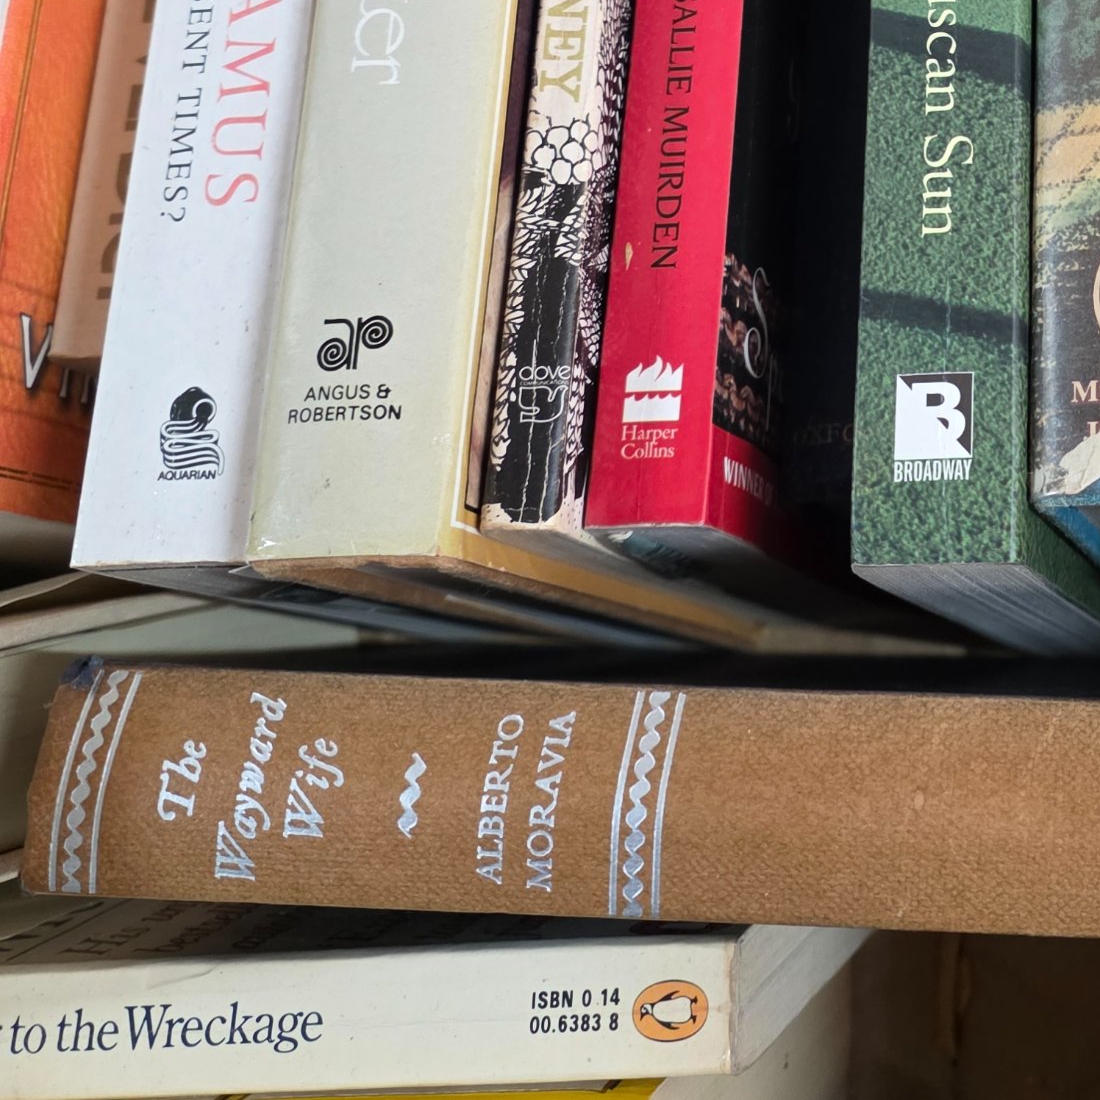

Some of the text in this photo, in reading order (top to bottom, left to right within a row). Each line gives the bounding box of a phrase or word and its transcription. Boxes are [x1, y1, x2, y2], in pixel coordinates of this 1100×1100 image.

[160, 86, 203, 223] TIMES?
[650, 106, 689, 270] MUIRDEN
[921, 132, 976, 238] Sun
[519, 365, 571, 380] dove
[304, 384, 391, 402] ANGUS &
[288, 404, 402, 424] ROBERTSON
[620, 442, 675, 460] Collins
[621, 424, 679, 443] Harper
[157, 468, 217, 482] AQUARIAN
[893, 459, 973, 483] BROADWAY
[157, 738, 208, 822] The
[214, 691, 288, 883] Wayward
[282, 735, 345, 839] Wife
[474, 712, 525, 886] ALBERTO
[524, 711, 577, 893] MORAVIA
[531, 988, 620, 1011] ISBN 0 14
[10, 1002, 325, 1055] to the Wreckage
[529, 1012, 620, 1035] 00.6383 8
